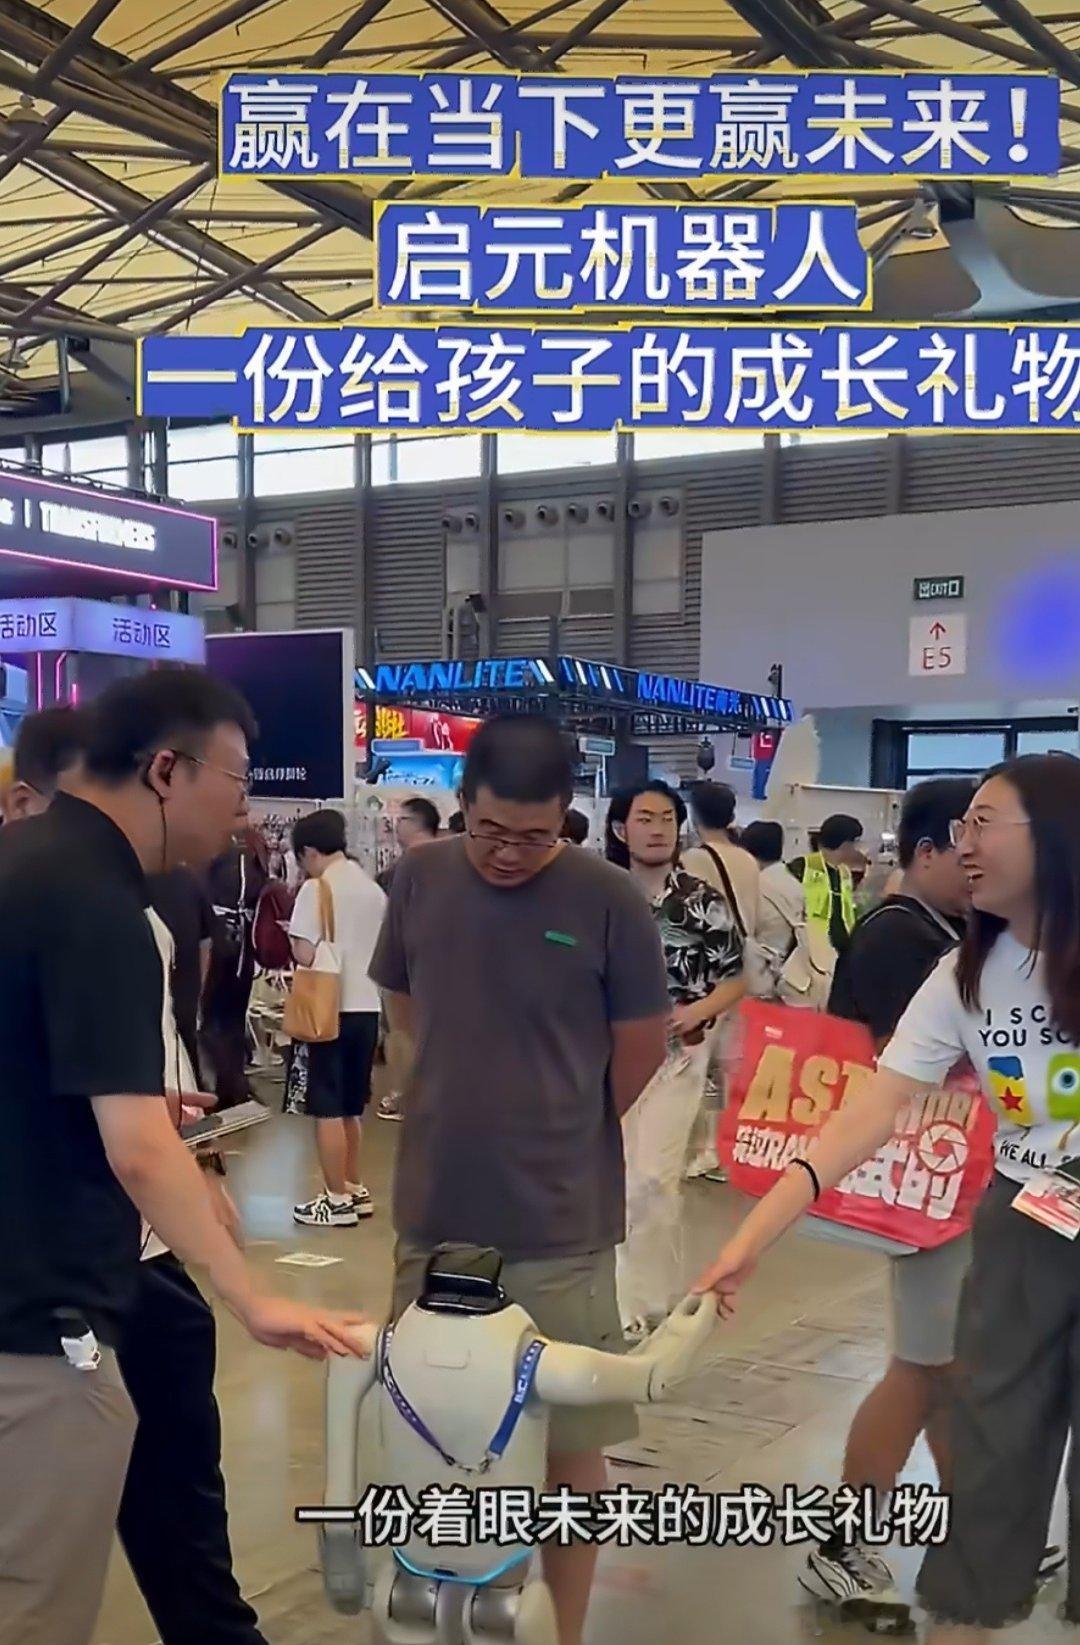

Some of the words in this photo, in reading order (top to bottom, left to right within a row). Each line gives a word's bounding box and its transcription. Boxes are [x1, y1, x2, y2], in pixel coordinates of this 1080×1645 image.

[113, 617, 171, 648] 活动区
[922, 646, 952, 670] E5
[376, 660, 527, 691] NANLITE
[985, 1008, 993, 1026] I
[1010, 1004, 1047, 1025] SC
[979, 1029, 1027, 1047] YOU
